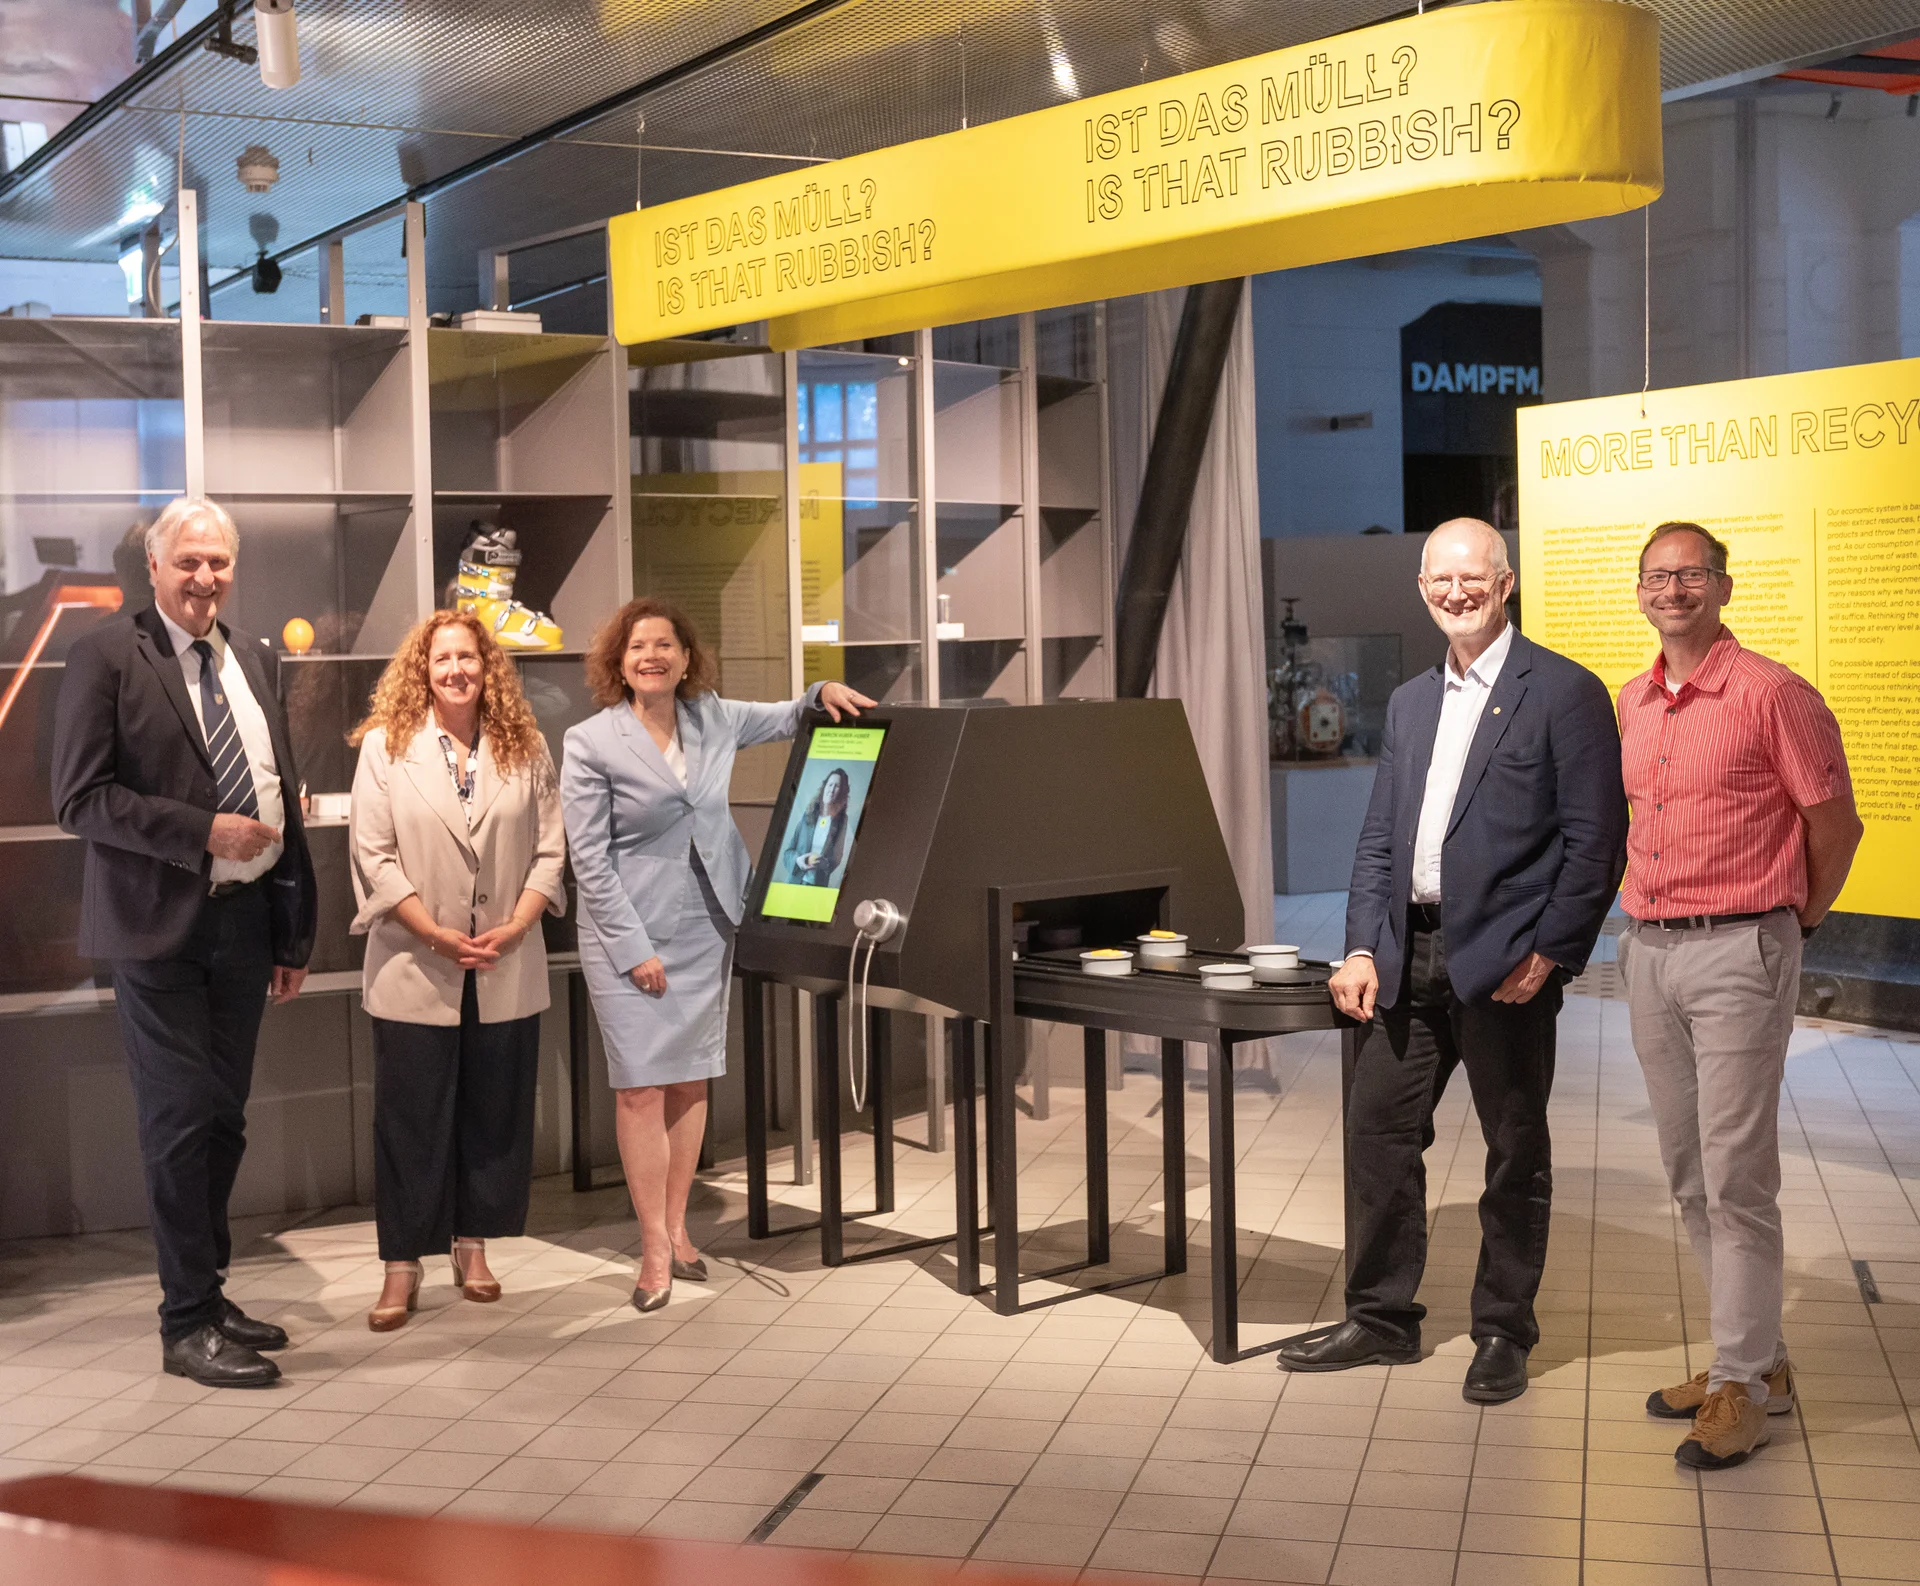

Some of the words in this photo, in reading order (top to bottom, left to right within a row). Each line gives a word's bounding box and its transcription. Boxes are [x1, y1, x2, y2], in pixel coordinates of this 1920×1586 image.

[1085, 106, 1148, 163] IST
[1159, 84, 1248, 147] DAS
[1260, 45, 1417, 125] MÜLL?
[1087, 173, 1123, 222] IS
[1134, 148, 1246, 211] THAT
[1260, 98, 1521, 189] RUBBISH?
[655, 222, 698, 268] IST
[706, 206, 766, 256] DAS
[774, 178, 877, 241] MÜLL?
[658, 277, 685, 317] IS
[691, 257, 766, 309] THAT
[776, 219, 937, 292] RUBBISH?
[1412, 362, 1544, 396] DAMPFM
[1541, 429, 1653, 478] MORE
[1661, 416, 1777, 466] THAN
[1791, 399, 1920, 455] RECY
[1827, 508, 1839, 516] Our
[1841, 506, 1874, 515] economic
[1876, 505, 1900, 514] system
[1852, 518, 1877, 526] extract
[1734, 525, 1784, 534] Veränderungen
[1828, 531, 1858, 540] products
[1867, 540, 1914, 548] consumption
[1755, 558, 1800, 567] ausgewählten
[1828, 566, 1862, 575] proaching
[1870, 565, 1900, 573] breaking
[1828, 579, 1851, 587] people
[1828, 590, 1846, 598] many
[1853, 600, 1888, 608] threshold,
[1868, 612, 1905, 620] Rethinking
[1840, 625, 1865, 633] change
[1876, 624, 1895, 632] every
[1897, 623, 1913, 631] level
[1829, 659, 1843, 667] One
[1844, 660, 1873, 668] possible
[1875, 660, 1908, 668] approach
[1872, 730, 1885, 739] just
[1901, 730, 1909, 738] of
[1890, 766, 1912, 774] These
[1901, 790, 1915, 799] into
